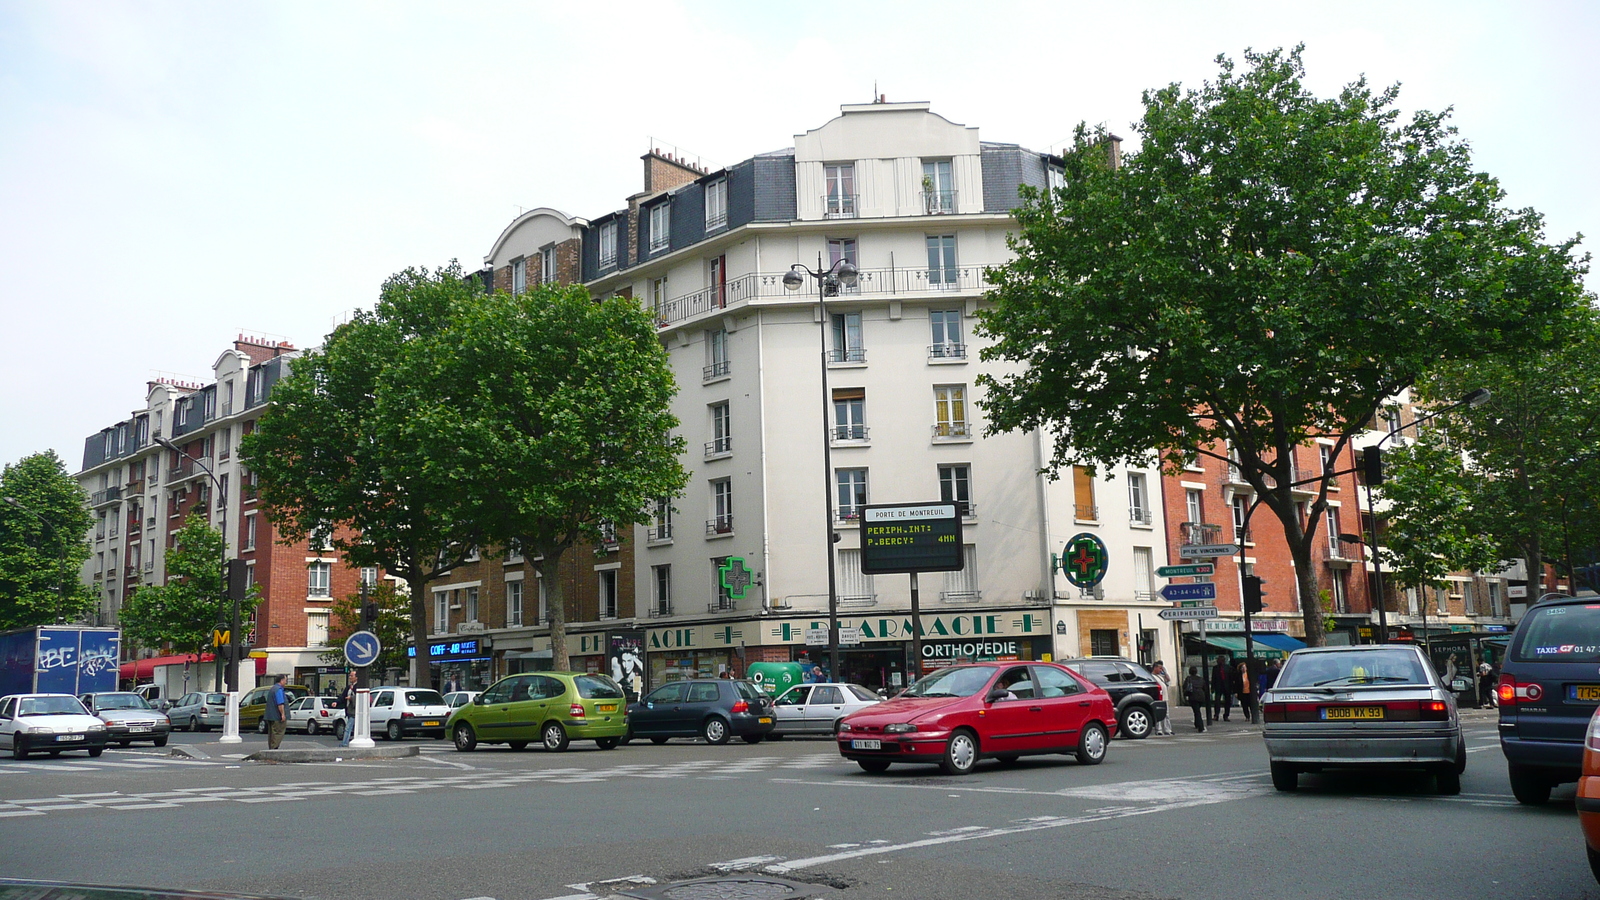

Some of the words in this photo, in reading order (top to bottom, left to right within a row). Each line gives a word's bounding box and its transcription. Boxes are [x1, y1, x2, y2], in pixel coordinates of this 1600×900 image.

[909, 508, 944, 516] MONTREUIL
[938, 534, 956, 543] 4MN
[213, 629, 231, 647] M
[922, 642, 1016, 657] ORTHOPEDIE
[1434, 645, 1467, 653] SEPHORA
[1537, 646, 1557, 654] TAXIS
[1574, 645, 1583, 653] 01
[1586, 645, 1596, 653] 47
[1578, 687, 1600, 698] 775
[1328, 708, 1351, 718] 9008
[1354, 707, 1366, 717] WX
[1368, 707, 1381, 717] 93
